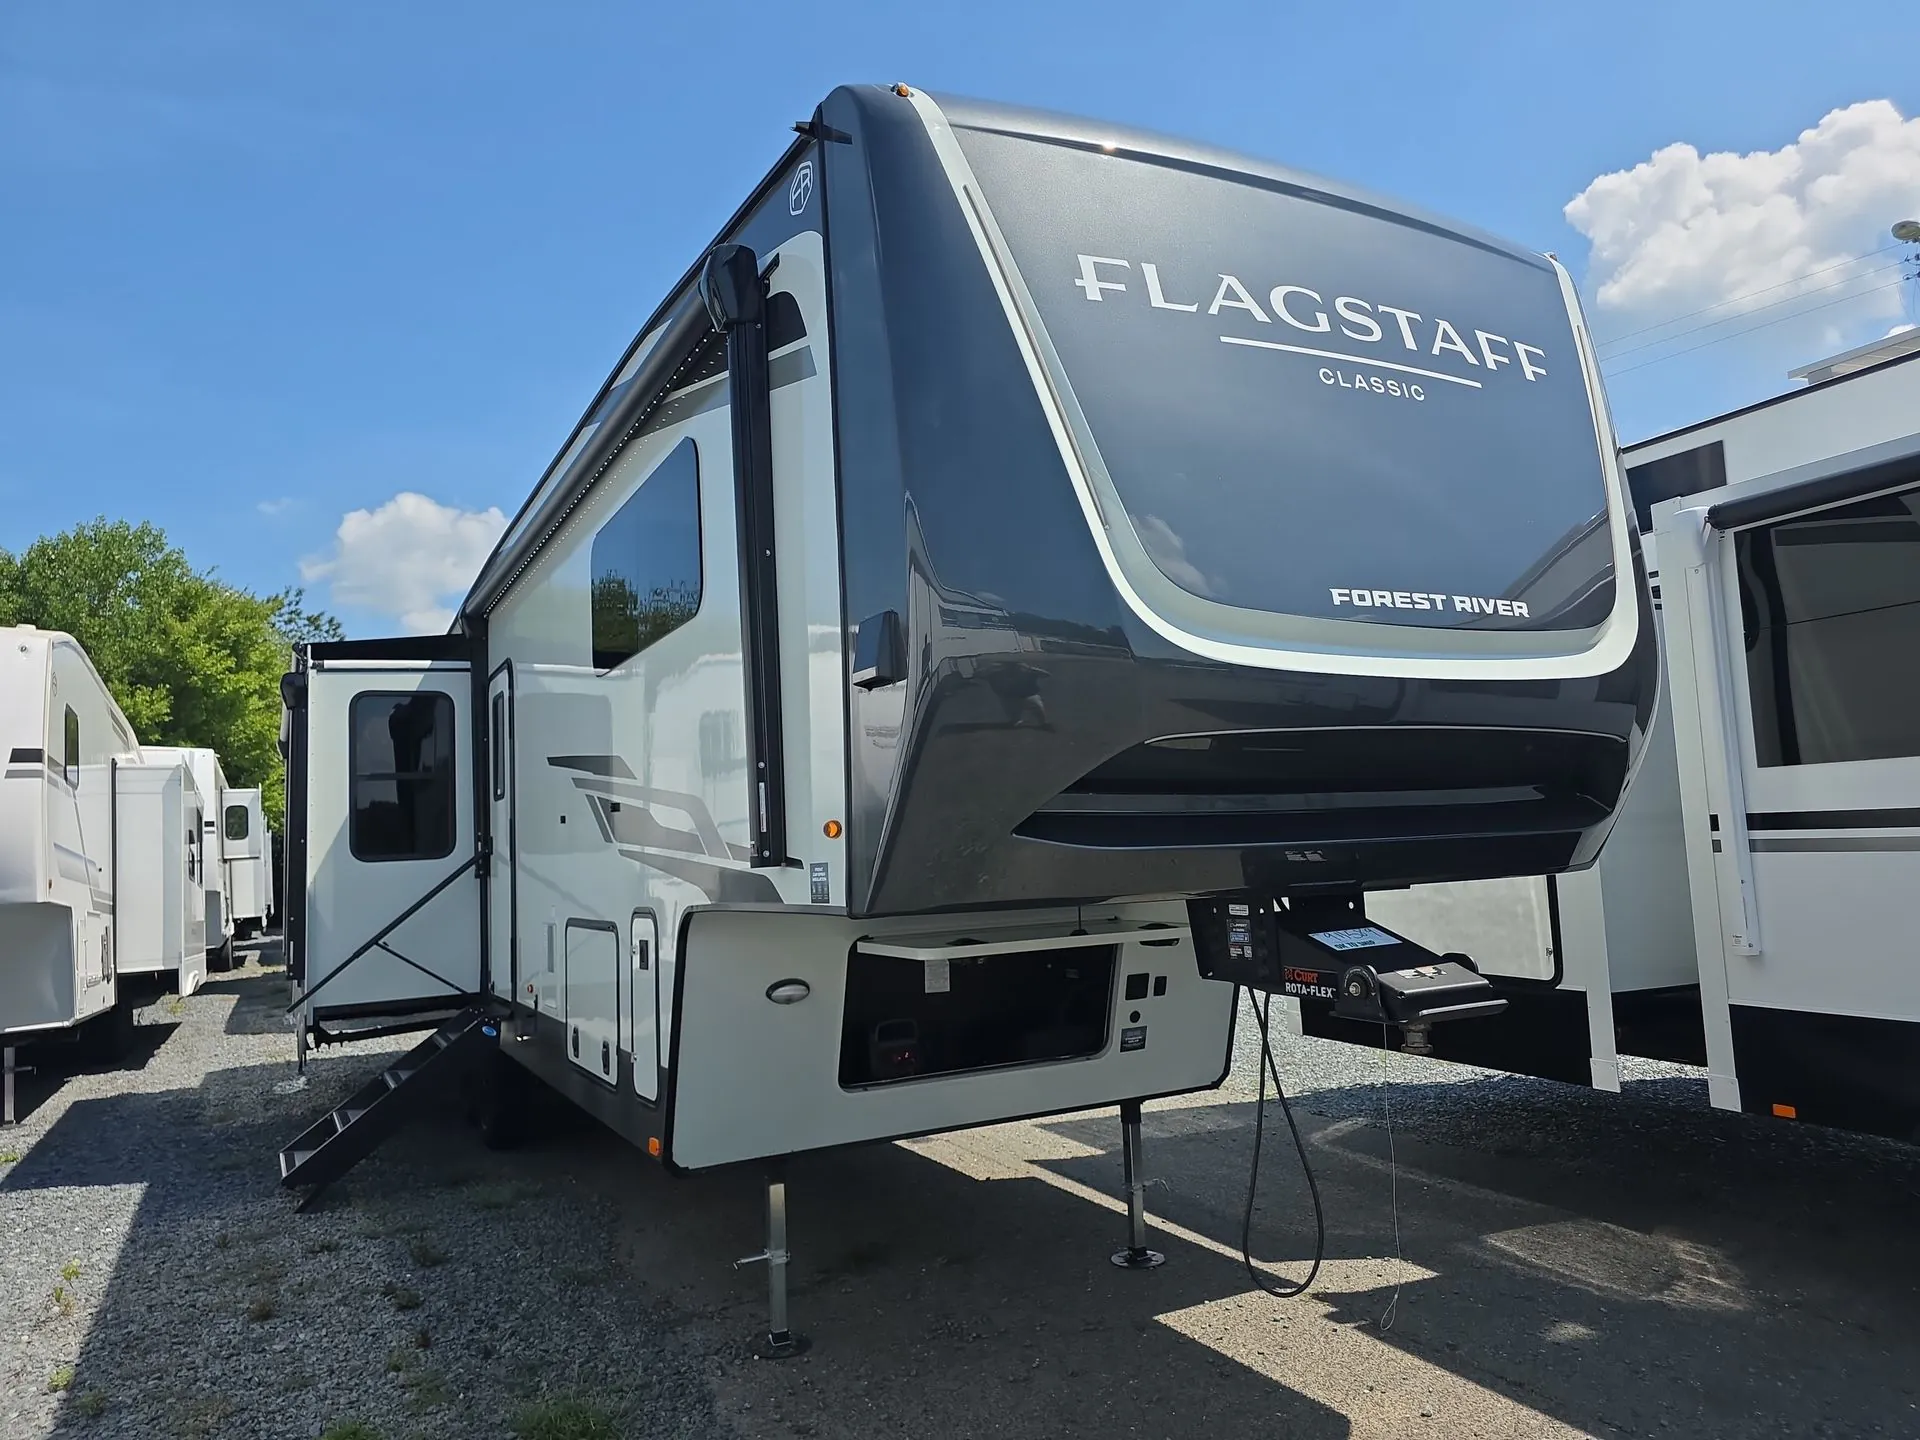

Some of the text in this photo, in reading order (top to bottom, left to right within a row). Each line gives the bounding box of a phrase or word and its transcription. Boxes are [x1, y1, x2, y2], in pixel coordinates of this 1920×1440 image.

[1074, 253, 1547, 382] FLAGSTAFF
[1318, 367, 1425, 401] CLASSIC
[1329, 588, 1530, 618] FOREST RIVER
[1294, 969, 1319, 983] CURT
